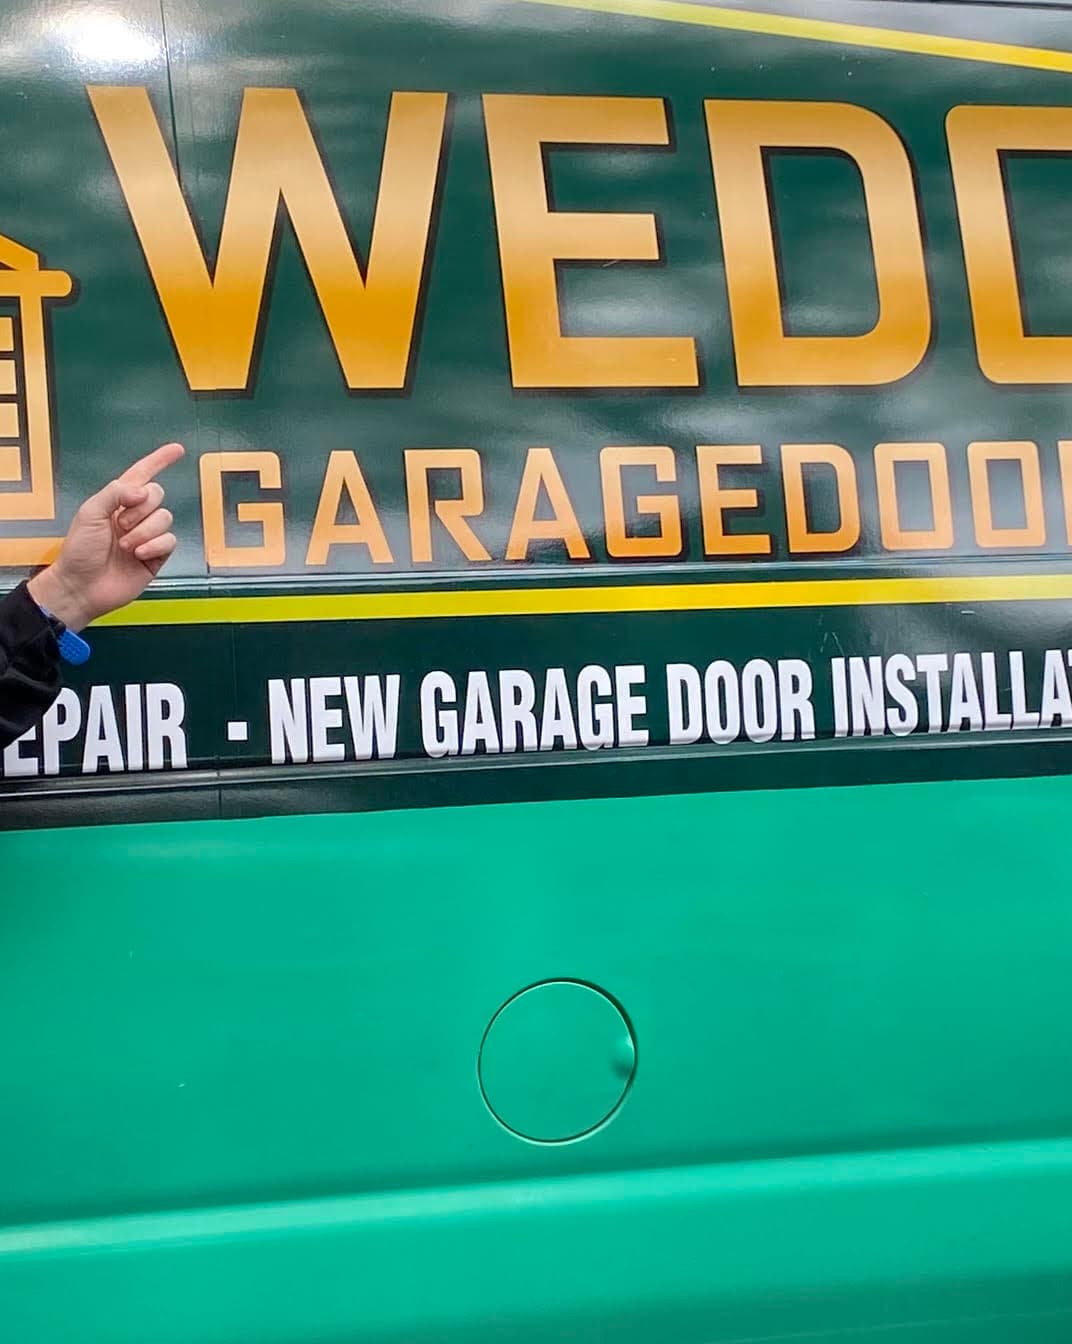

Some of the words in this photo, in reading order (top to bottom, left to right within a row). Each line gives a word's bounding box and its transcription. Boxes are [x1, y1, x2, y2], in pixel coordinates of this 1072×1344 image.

[268, 674, 401, 764] NEW
[420, 657, 650, 757] GARAGE
[668, 655, 814, 746] DOOR
